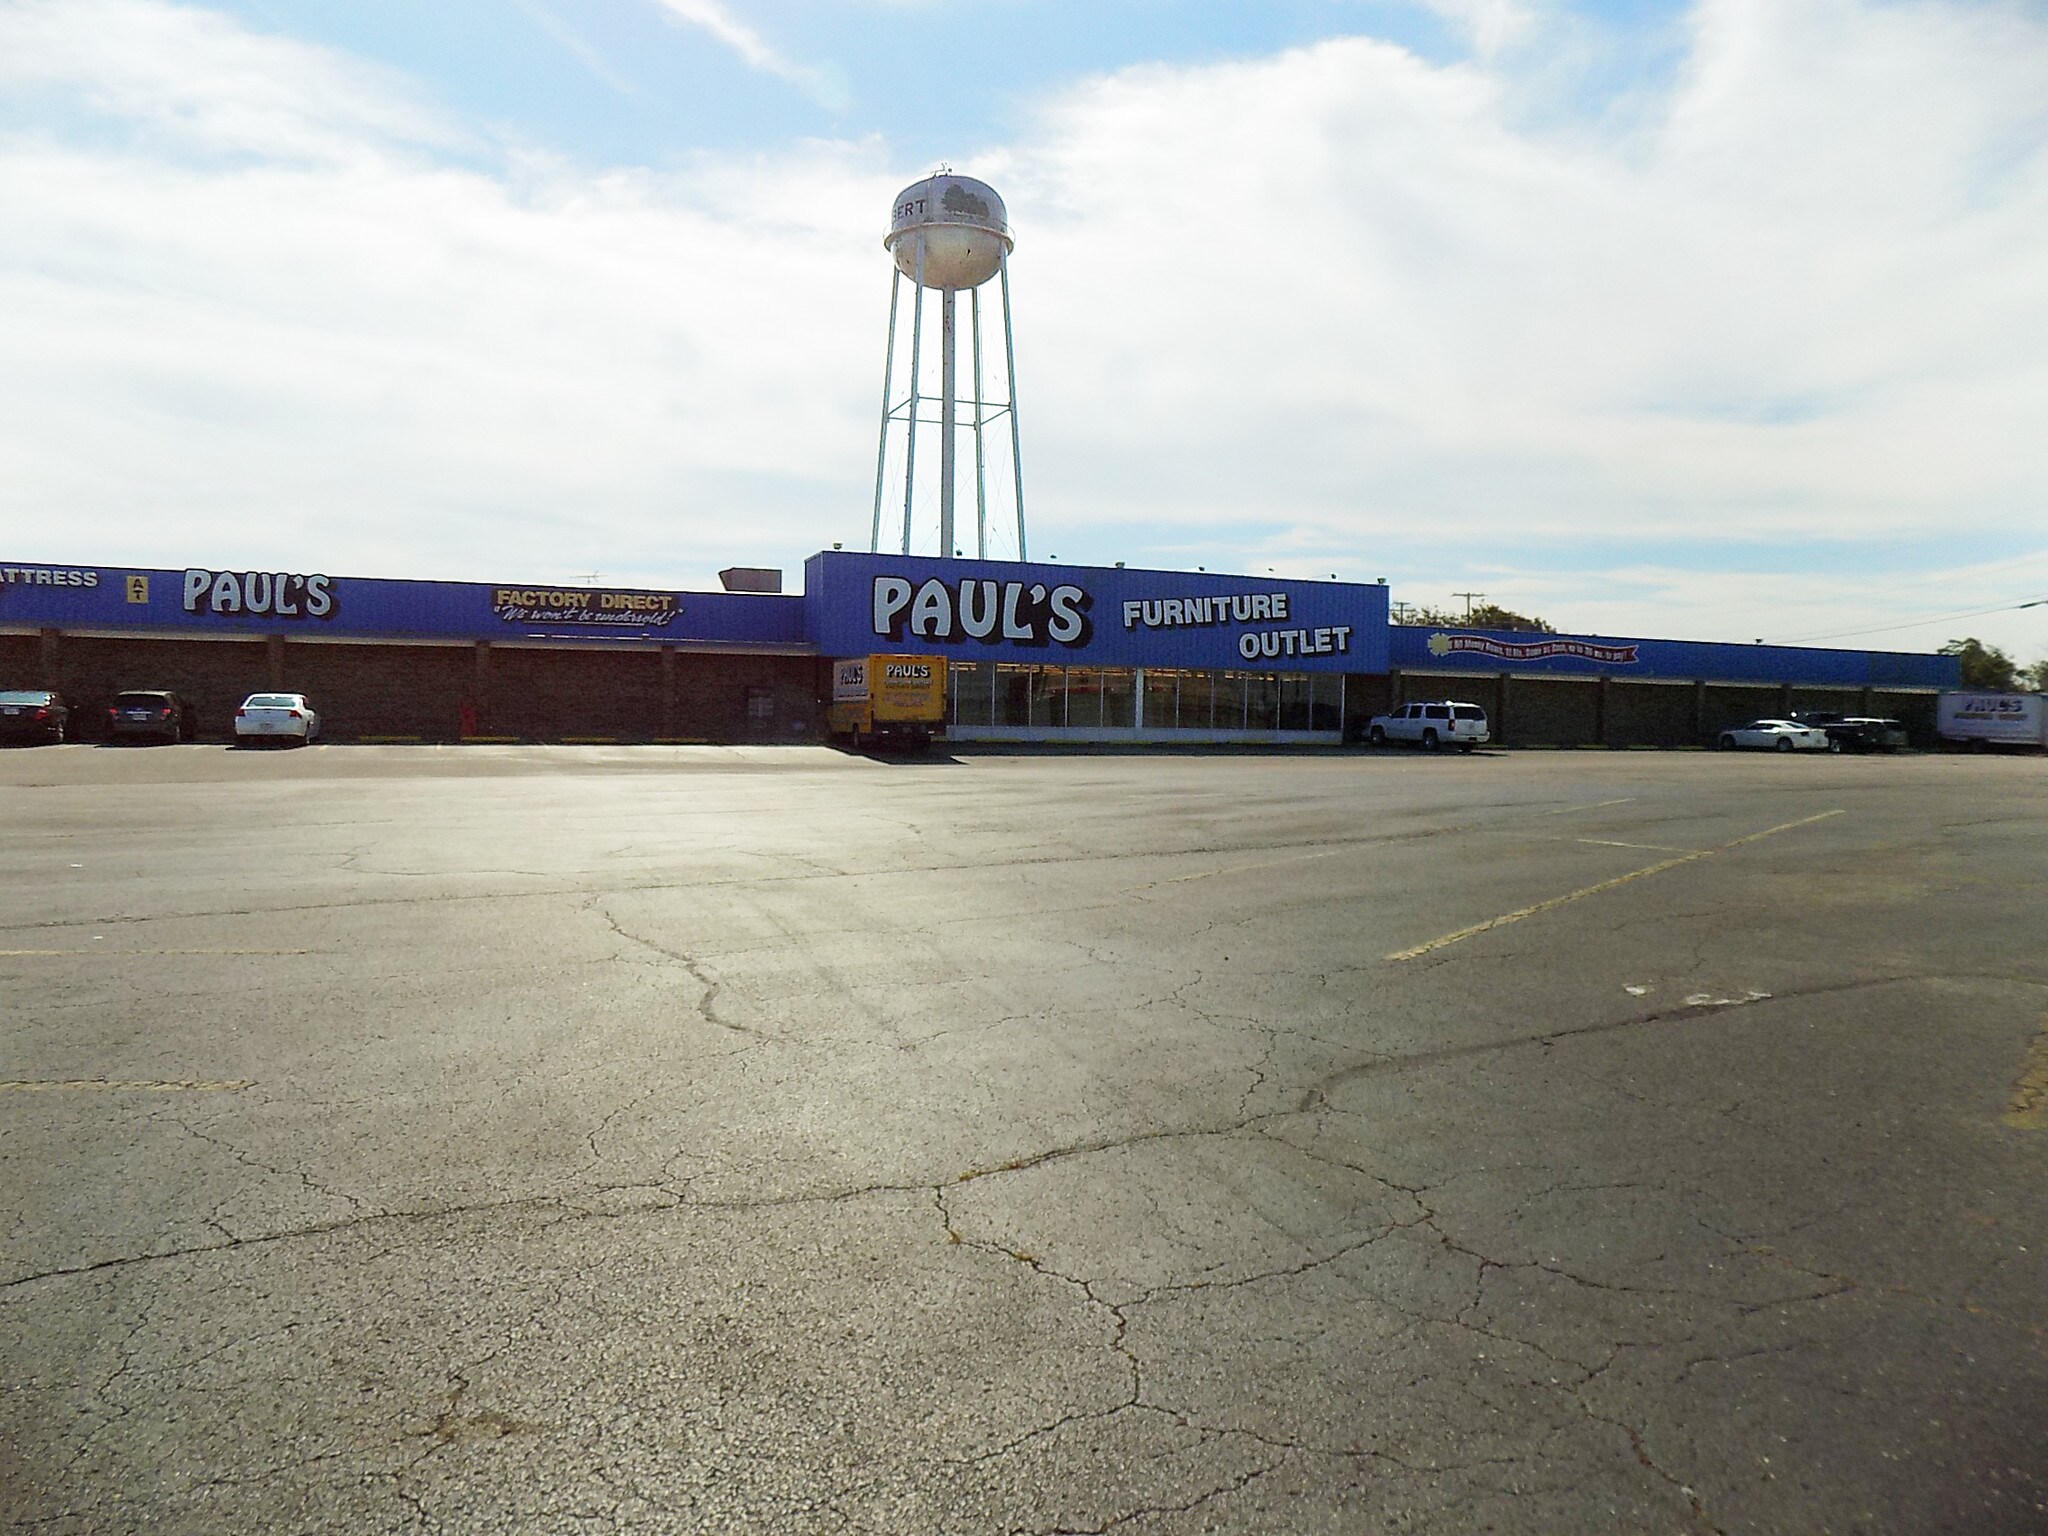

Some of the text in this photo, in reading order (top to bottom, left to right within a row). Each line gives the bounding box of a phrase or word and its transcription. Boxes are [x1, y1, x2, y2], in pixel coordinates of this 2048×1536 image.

[183, 568, 333, 617] PAUL'S
[497, 589, 672, 610] FACTORY DIRECT
[873, 576, 1084, 643] PAUL'S
[1122, 592, 1288, 628] FURNITURE
[1238, 626, 1351, 659] OUTLET
[886, 664, 930, 678] PAUL'S
